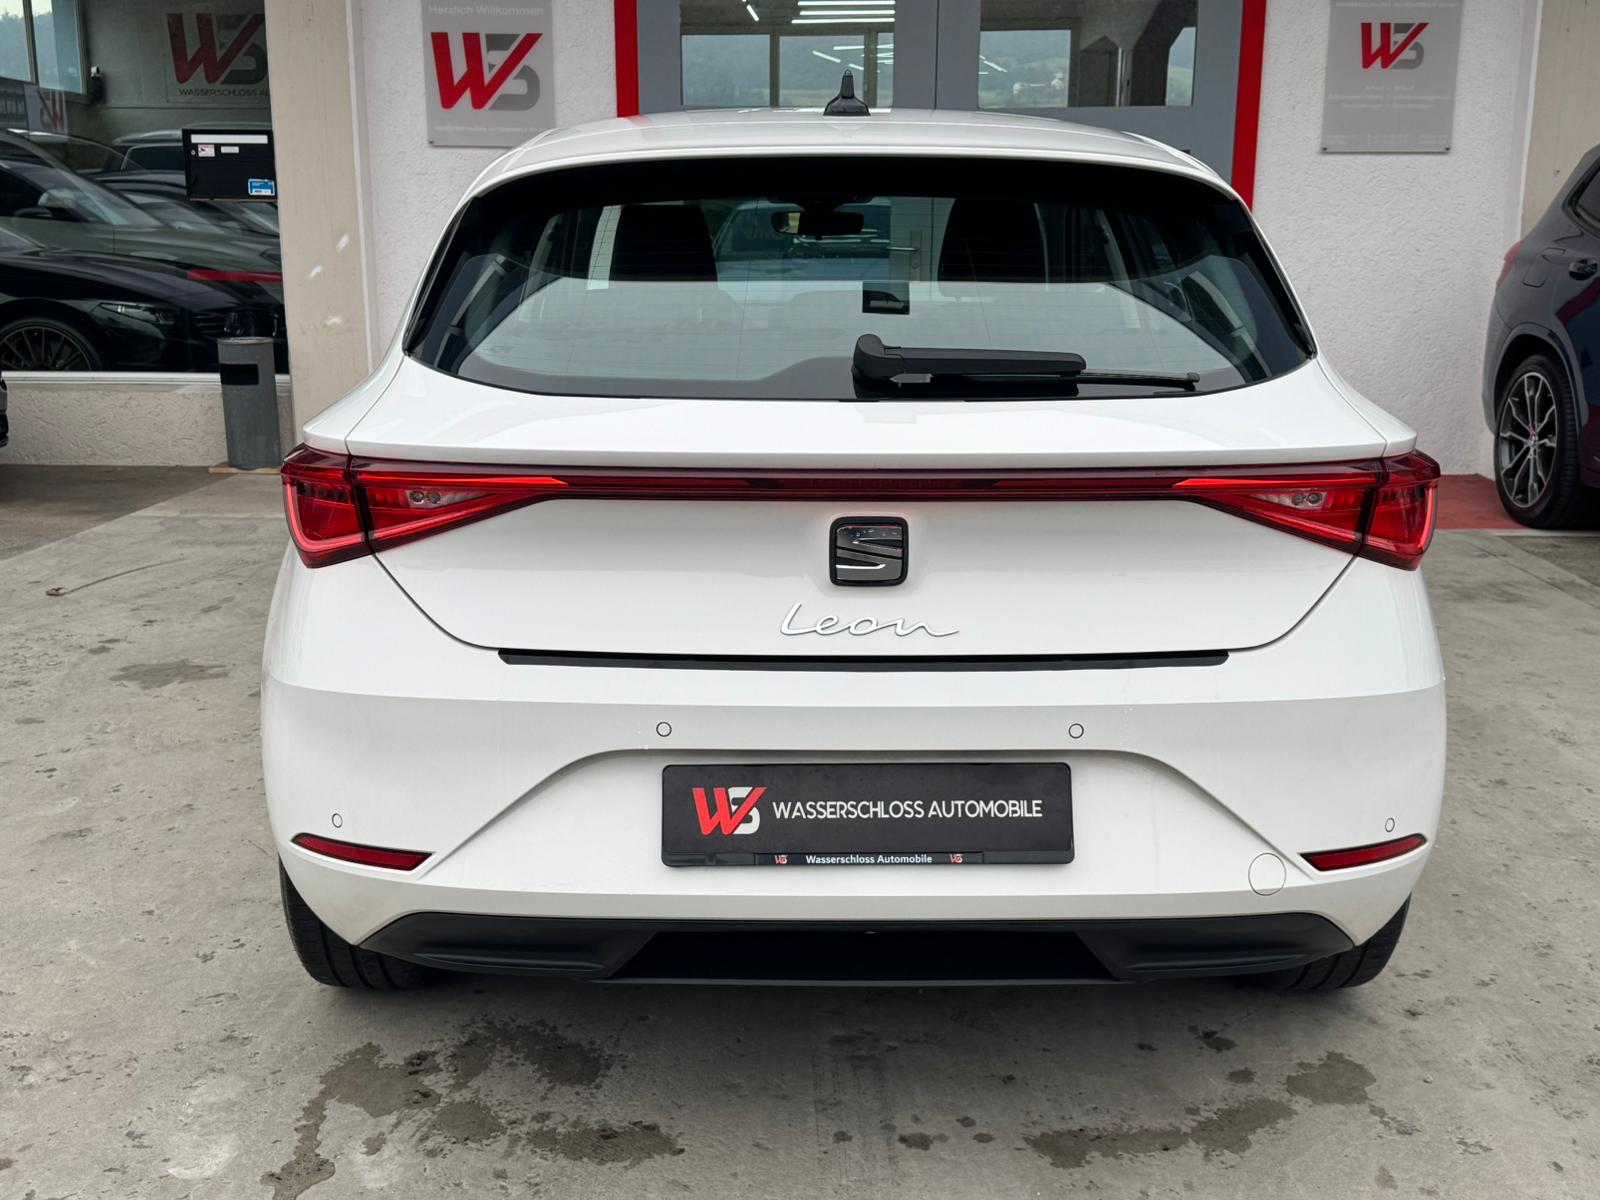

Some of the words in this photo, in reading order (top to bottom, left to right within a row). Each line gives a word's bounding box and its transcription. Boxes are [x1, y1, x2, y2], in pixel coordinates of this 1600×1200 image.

[428, 4, 474, 15] Herzlich
[475, 5, 544, 16] Willkommen
[178, 88, 258, 97] WASSERSCHLOSS
[780, 602, 960, 637] Leon
[772, 800, 925, 819] WASSERSCHLOSS
[927, 799, 1043, 818] AUTOMOBILE
[805, 854, 875, 864] Wasserschloss
[877, 853, 933, 864] Automobile
